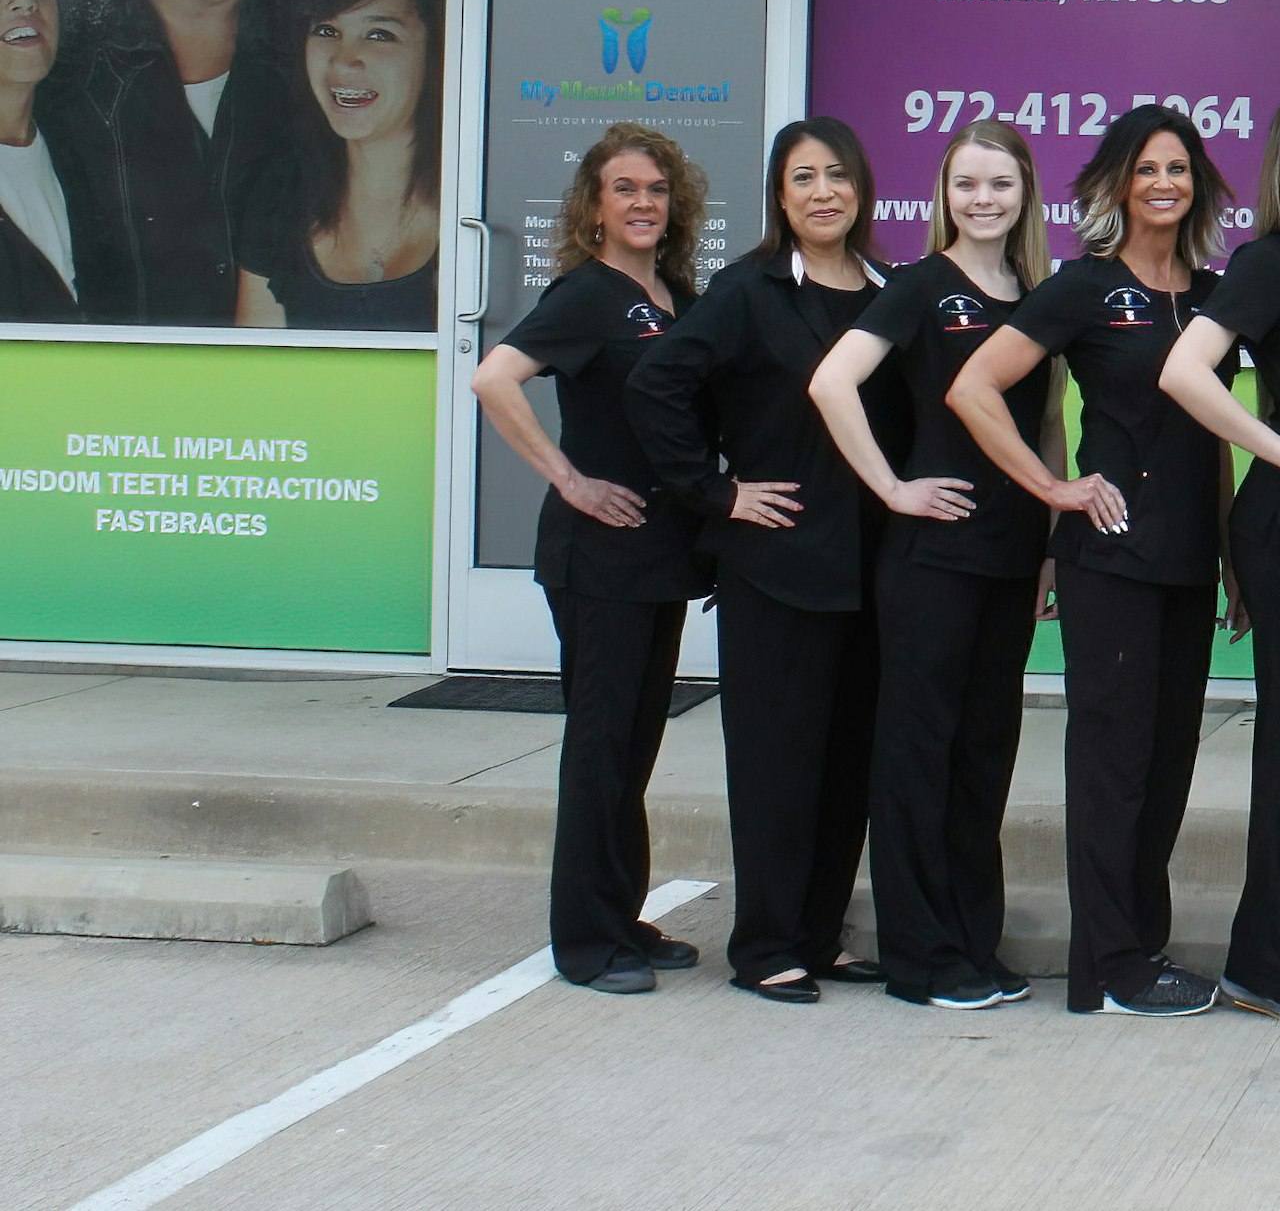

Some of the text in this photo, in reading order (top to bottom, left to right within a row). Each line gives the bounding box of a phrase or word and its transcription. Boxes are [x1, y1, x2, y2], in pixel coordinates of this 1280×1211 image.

[903, 89, 1254, 140] 972-412-64
[66, 433, 308, 463] DENTAL IMPLANTS
[107, 472, 188, 496] TEETH
[198, 475, 379, 502] EXTRACTIONS
[95, 508, 268, 537] FASTBRACES
